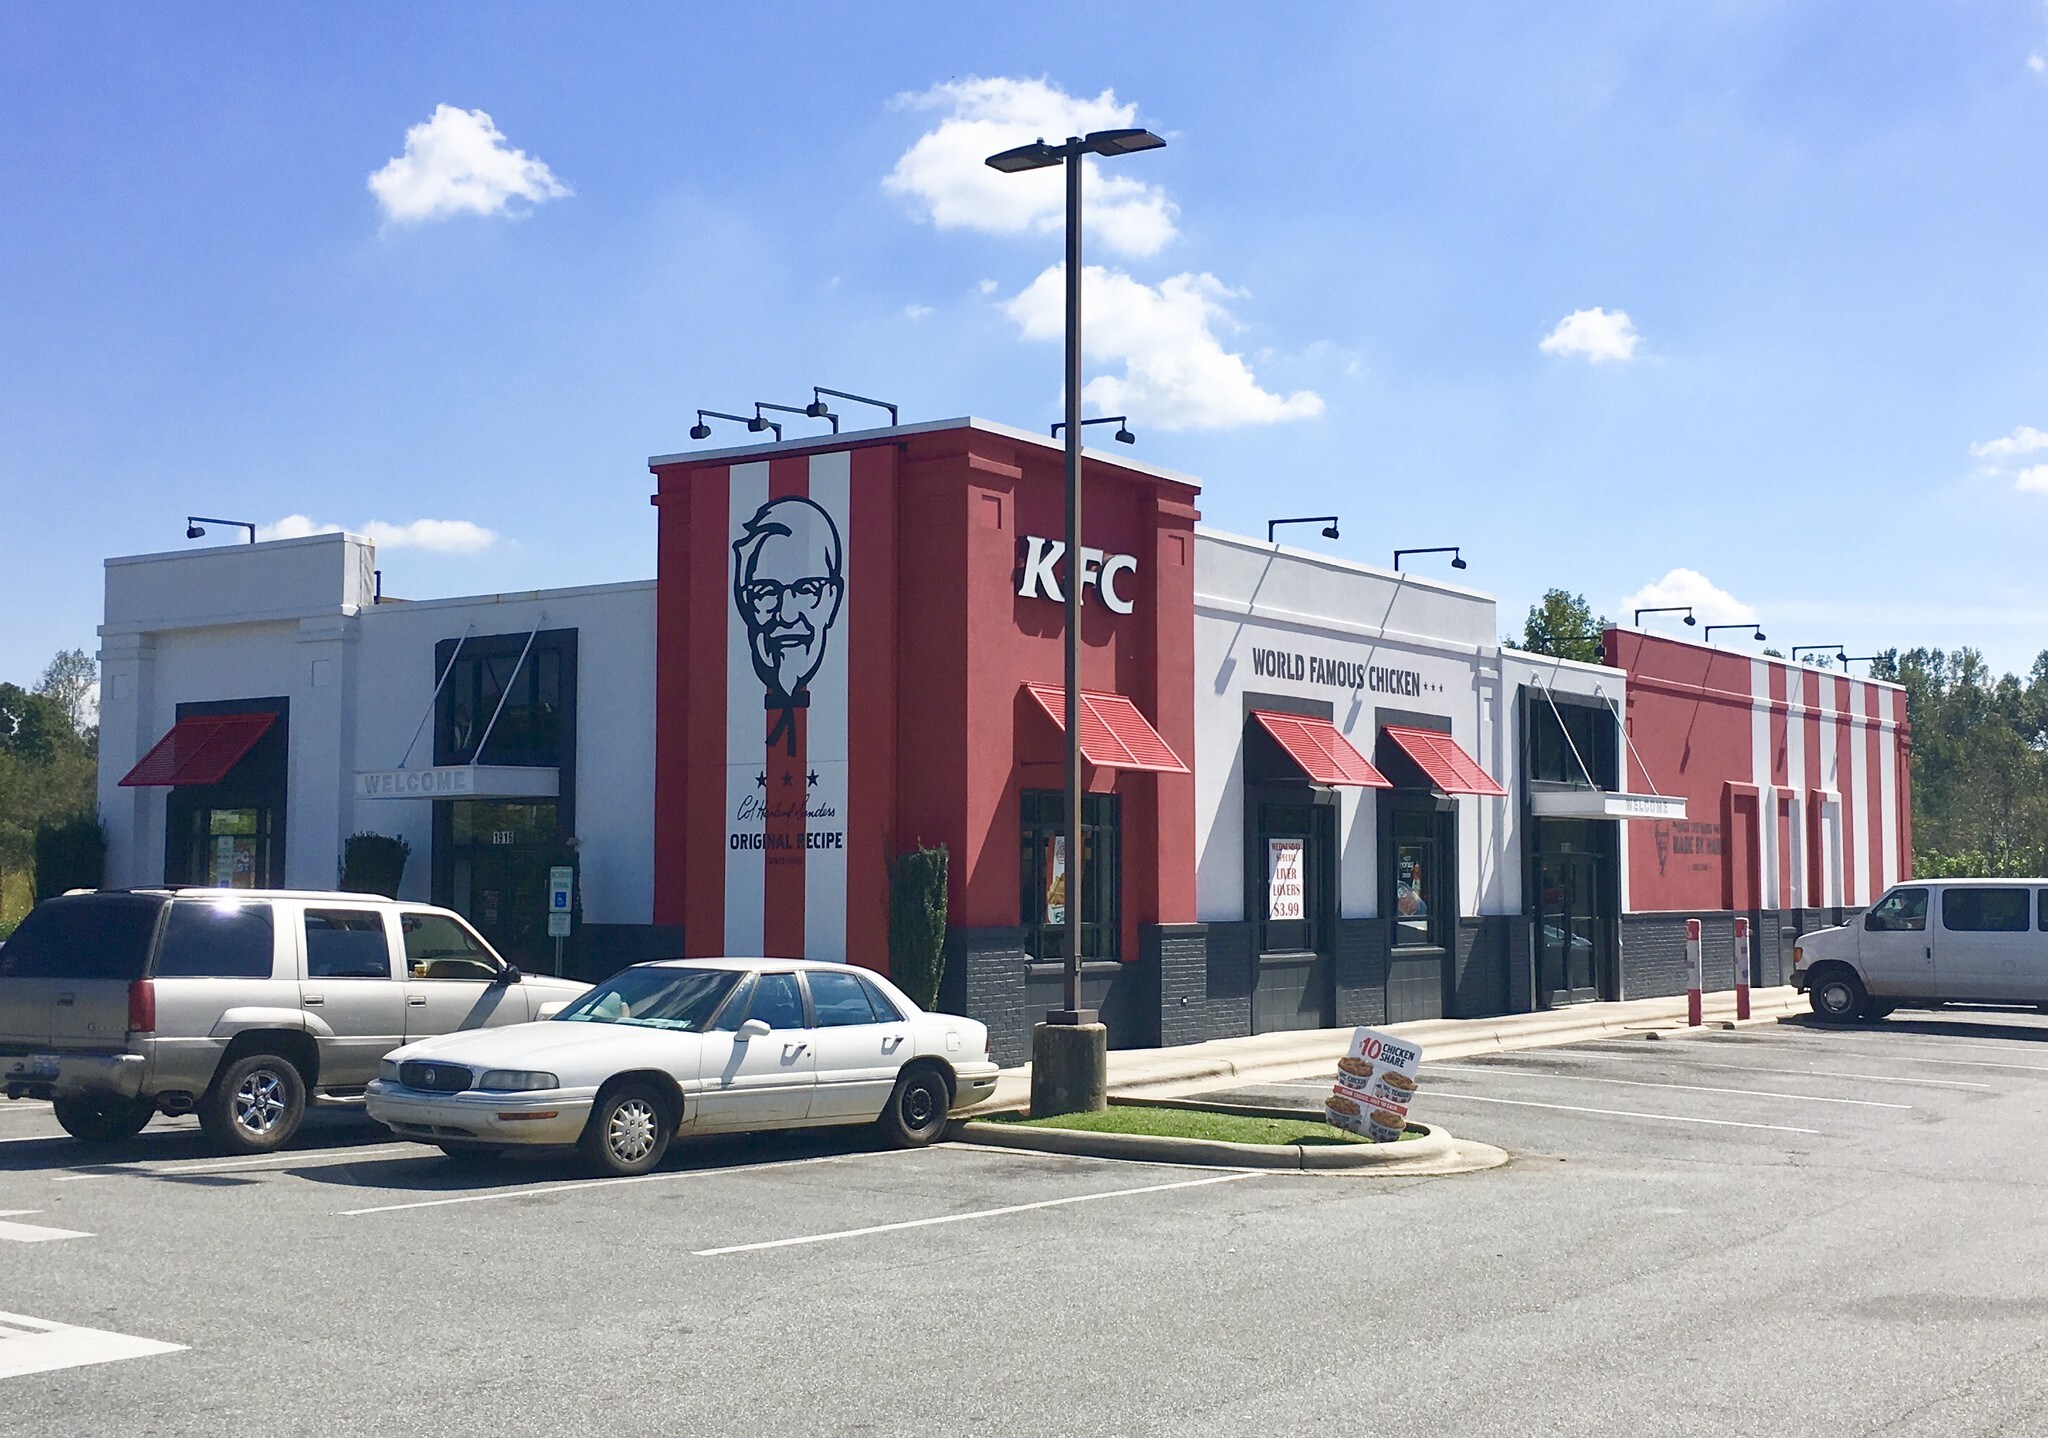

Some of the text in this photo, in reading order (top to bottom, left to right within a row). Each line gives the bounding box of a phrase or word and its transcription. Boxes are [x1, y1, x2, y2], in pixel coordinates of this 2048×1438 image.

[1018, 535, 1138, 614] KFC
[1252, 647, 1421, 697] WORLD FAMOUS CHICKEN
[365, 771, 466, 794] WELCOME
[1626, 799, 1669, 814] WELCOME
[493, 831, 515, 844] 1916
[730, 832, 843, 850] ORIGINAL RECIPE
[1276, 868, 1297, 880] LIVER
[1273, 884, 1301, 896] LOVERS
[1273, 902, 1300, 917] $3.99
[1379, 1052, 1406, 1068] SHARE
[1383, 1043, 1416, 1061] CHICKEN
